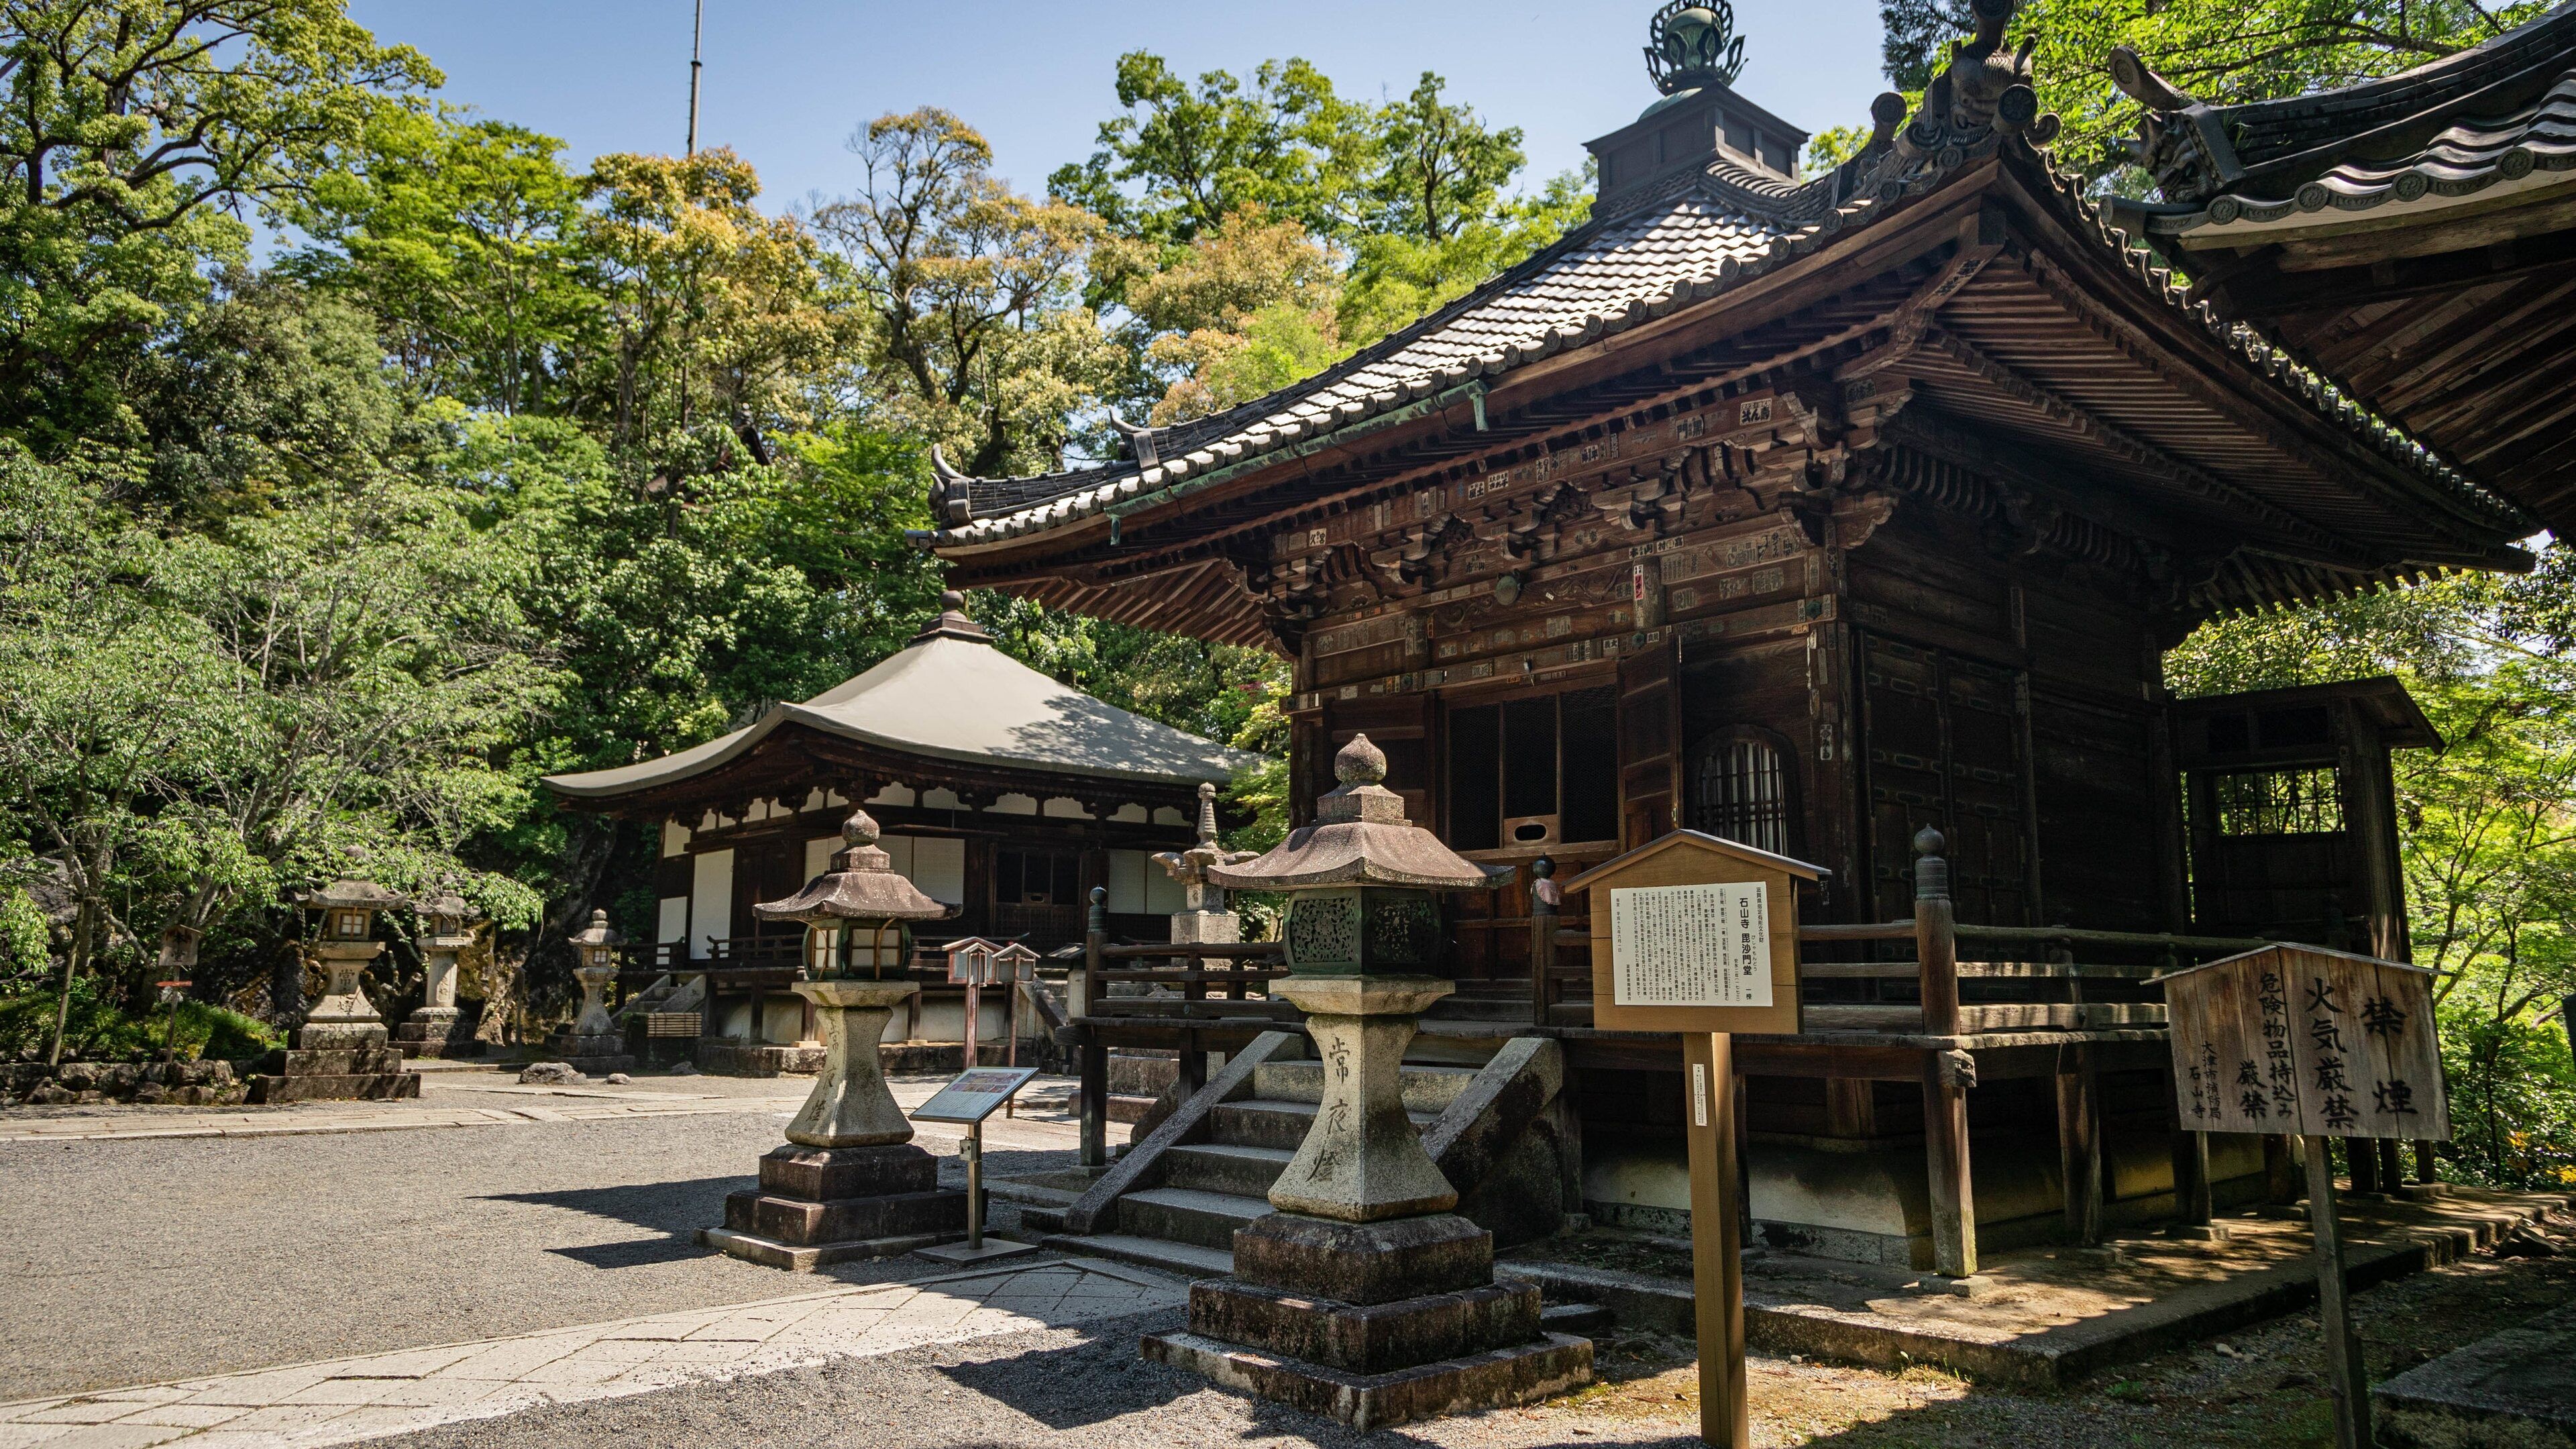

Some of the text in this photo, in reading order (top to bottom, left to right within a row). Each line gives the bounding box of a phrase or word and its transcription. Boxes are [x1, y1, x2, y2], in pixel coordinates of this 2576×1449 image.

[1739, 898, 1750, 928] 石山寺
[1741, 933, 1752, 975] 毘沙門堂
[2259, 972, 2295, 1119] 危険物品持込み
[2305, 977, 2359, 1130] 火気厳禁
[2360, 997, 2418, 1114] 禁煙
[2188, 1066, 2206, 1120] 石山寺
[2236, 1060, 2270, 1119] 厳禁
